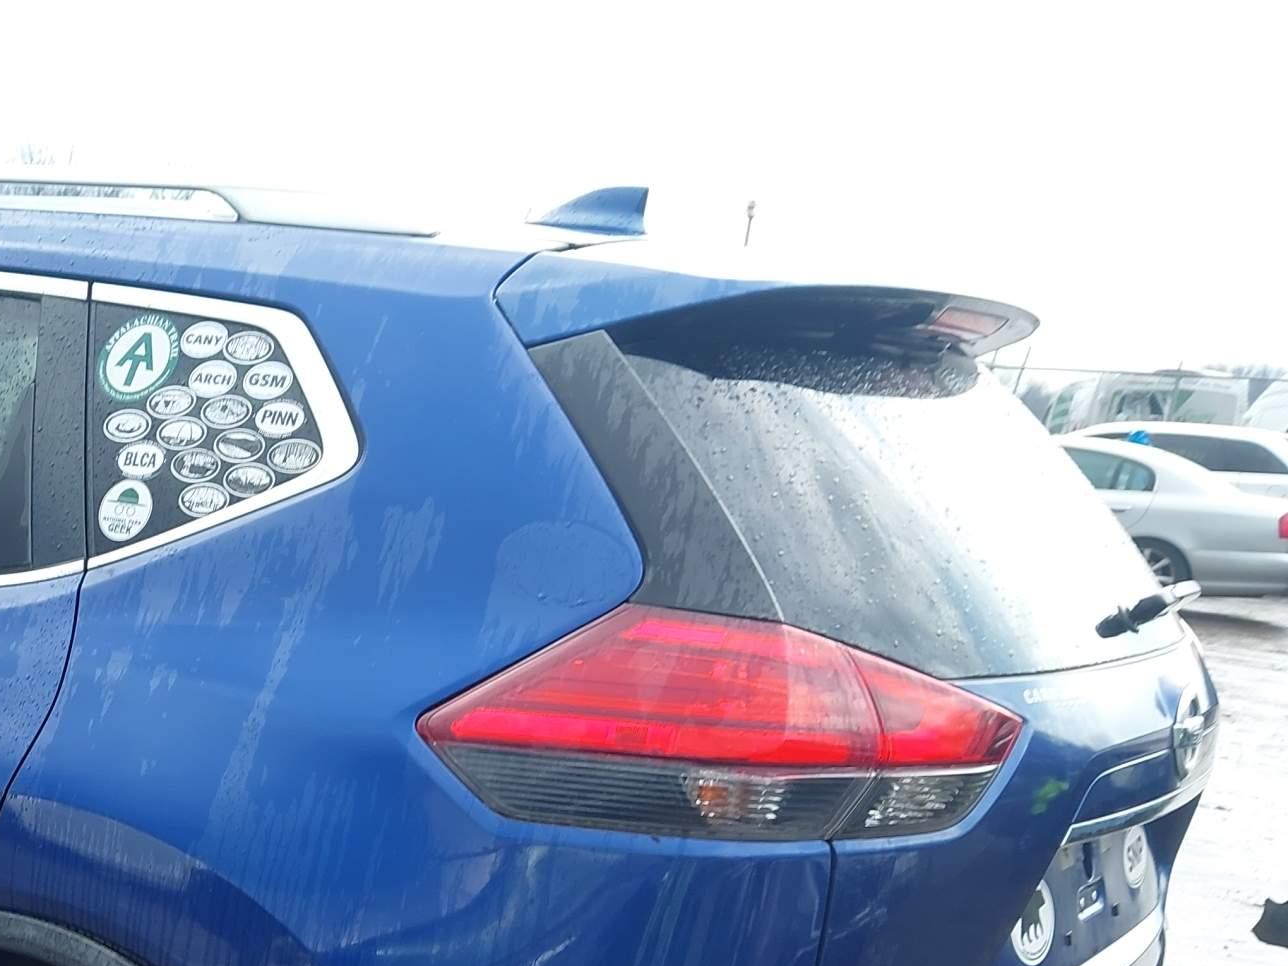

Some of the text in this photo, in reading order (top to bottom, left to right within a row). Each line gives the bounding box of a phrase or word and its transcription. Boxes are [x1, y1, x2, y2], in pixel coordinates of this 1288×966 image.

[185, 334, 223, 346] CANY
[193, 373, 232, 385] ARCH
[248, 373, 287, 388] GSM
[260, 409, 299, 426] PINN
[123, 452, 157, 468] BLCA
